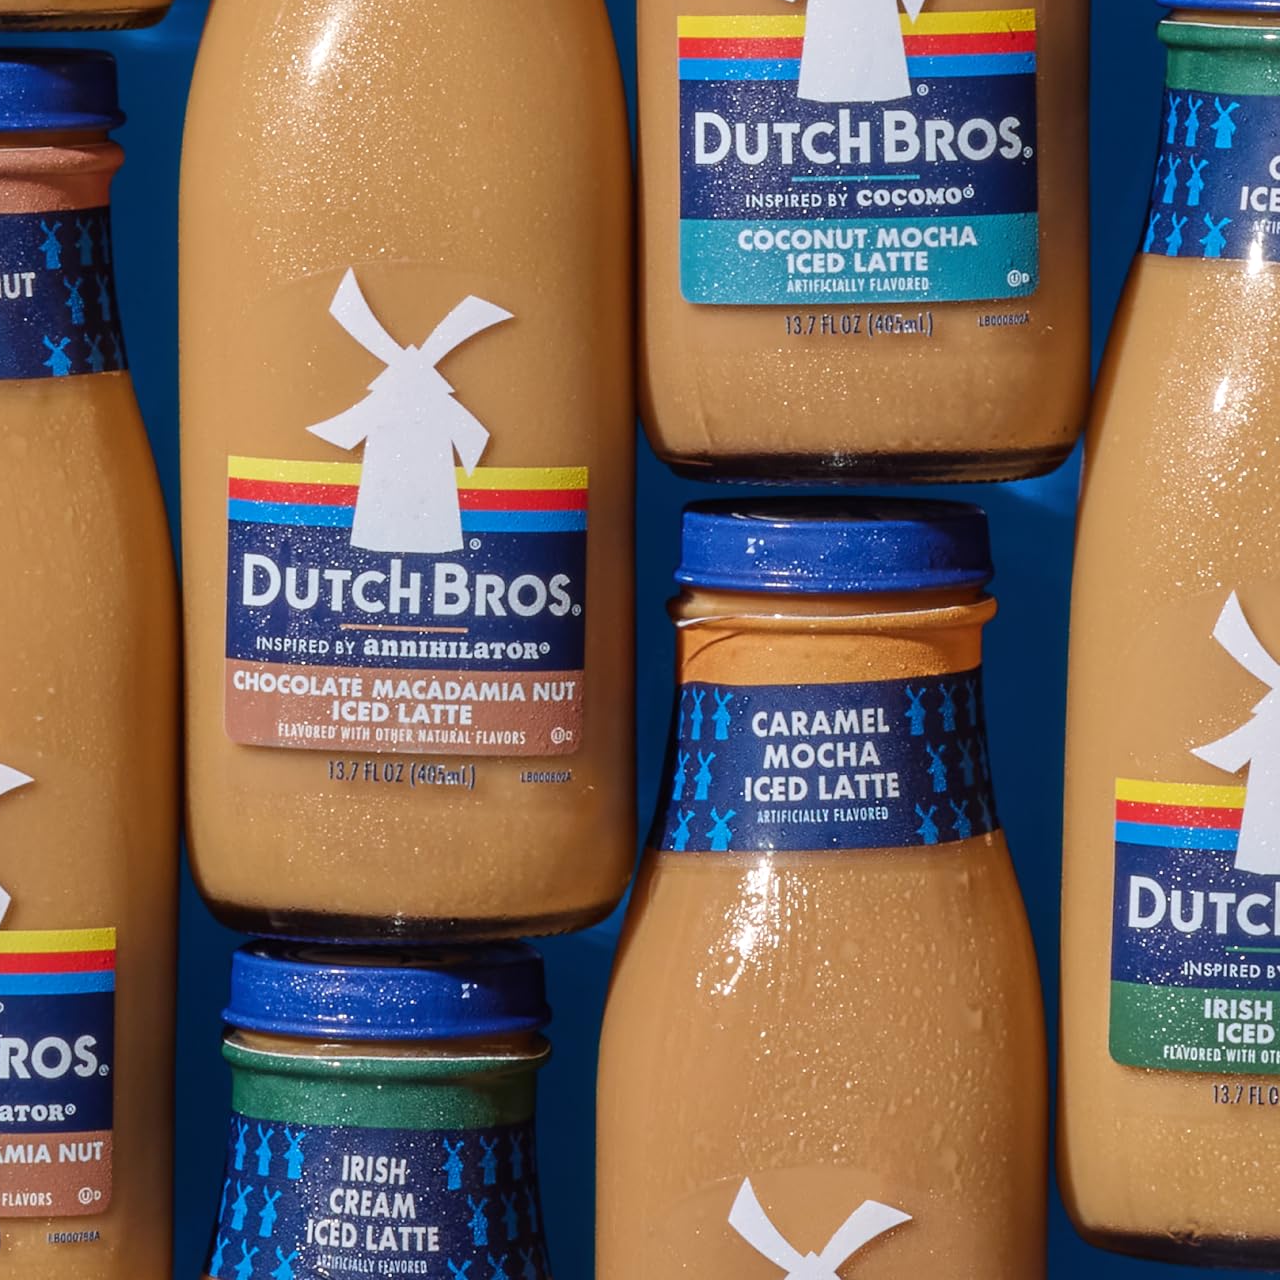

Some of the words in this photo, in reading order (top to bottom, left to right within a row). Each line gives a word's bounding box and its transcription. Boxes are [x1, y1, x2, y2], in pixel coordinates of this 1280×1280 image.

[746, 194, 821, 208] INSPIRED
[828, 194, 848, 207] BY
[738, 229, 868, 251] COCONUT
[877, 226, 977, 248] MOCHA
[786, 252, 844, 273] ICED
[854, 251, 928, 272] LATTE
[256, 637, 329, 653] INSPIRED
[335, 641, 355, 654] BY
[233, 671, 362, 697] CHOCOLATE
[372, 679, 525, 701] MACADAMIA
[532, 682, 575, 701] NUT
[332, 702, 390, 722] ICED
[398, 704, 472, 724] LATTE
[752, 708, 890, 737] CARAMEL
[763, 742, 880, 769] MOCHA
[745, 776, 808, 802] ICED
[819, 773, 899, 800] LATTE
[1184, 962, 1260, 978] INSPIRED
[1204, 999, 1272, 1020] IRISH
[1218, 1023, 1275, 1044] ICED
[1164, 1046, 1221, 1061] FLAVORED
[1226, 1049, 1255, 1063] WITH
[59, 1142, 103, 1162] NUT
[342, 1155, 406, 1185] IRISH
[2, 1192, 52, 1206] FLAVORS
[330, 1189, 416, 1218] CREAM
[306, 1219, 357, 1247] ICED
[366, 1226, 440, 1252] LATTE
